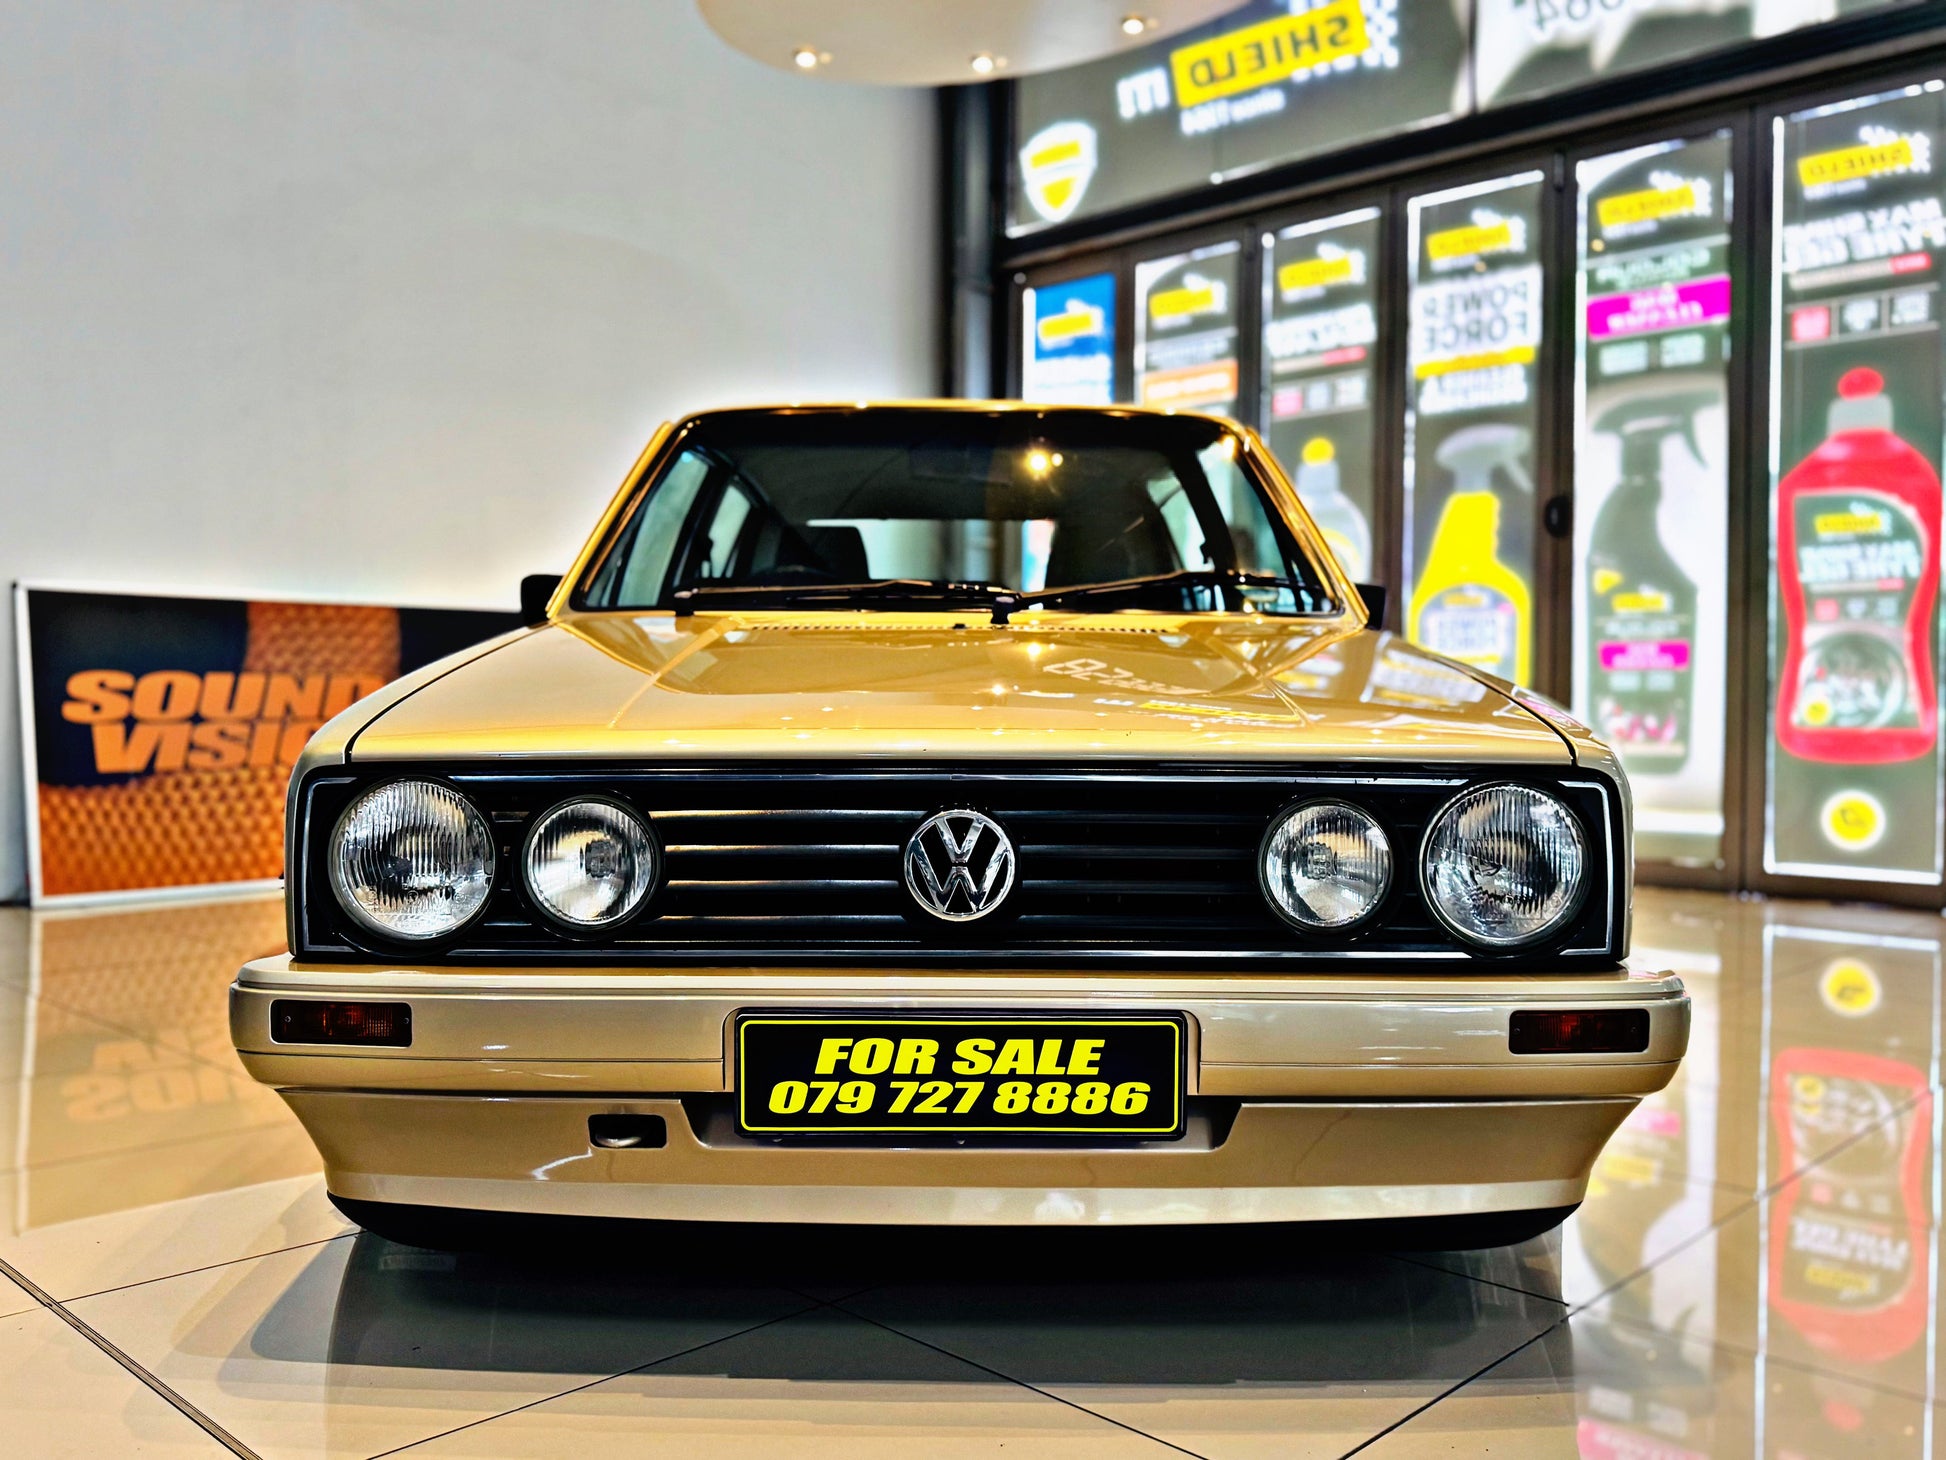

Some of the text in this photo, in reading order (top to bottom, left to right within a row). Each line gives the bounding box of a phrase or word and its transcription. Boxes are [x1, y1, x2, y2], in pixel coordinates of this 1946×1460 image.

[814, 1037, 1106, 1075] FOR SALE
[768, 1080, 1151, 1116] 079 727 8886
